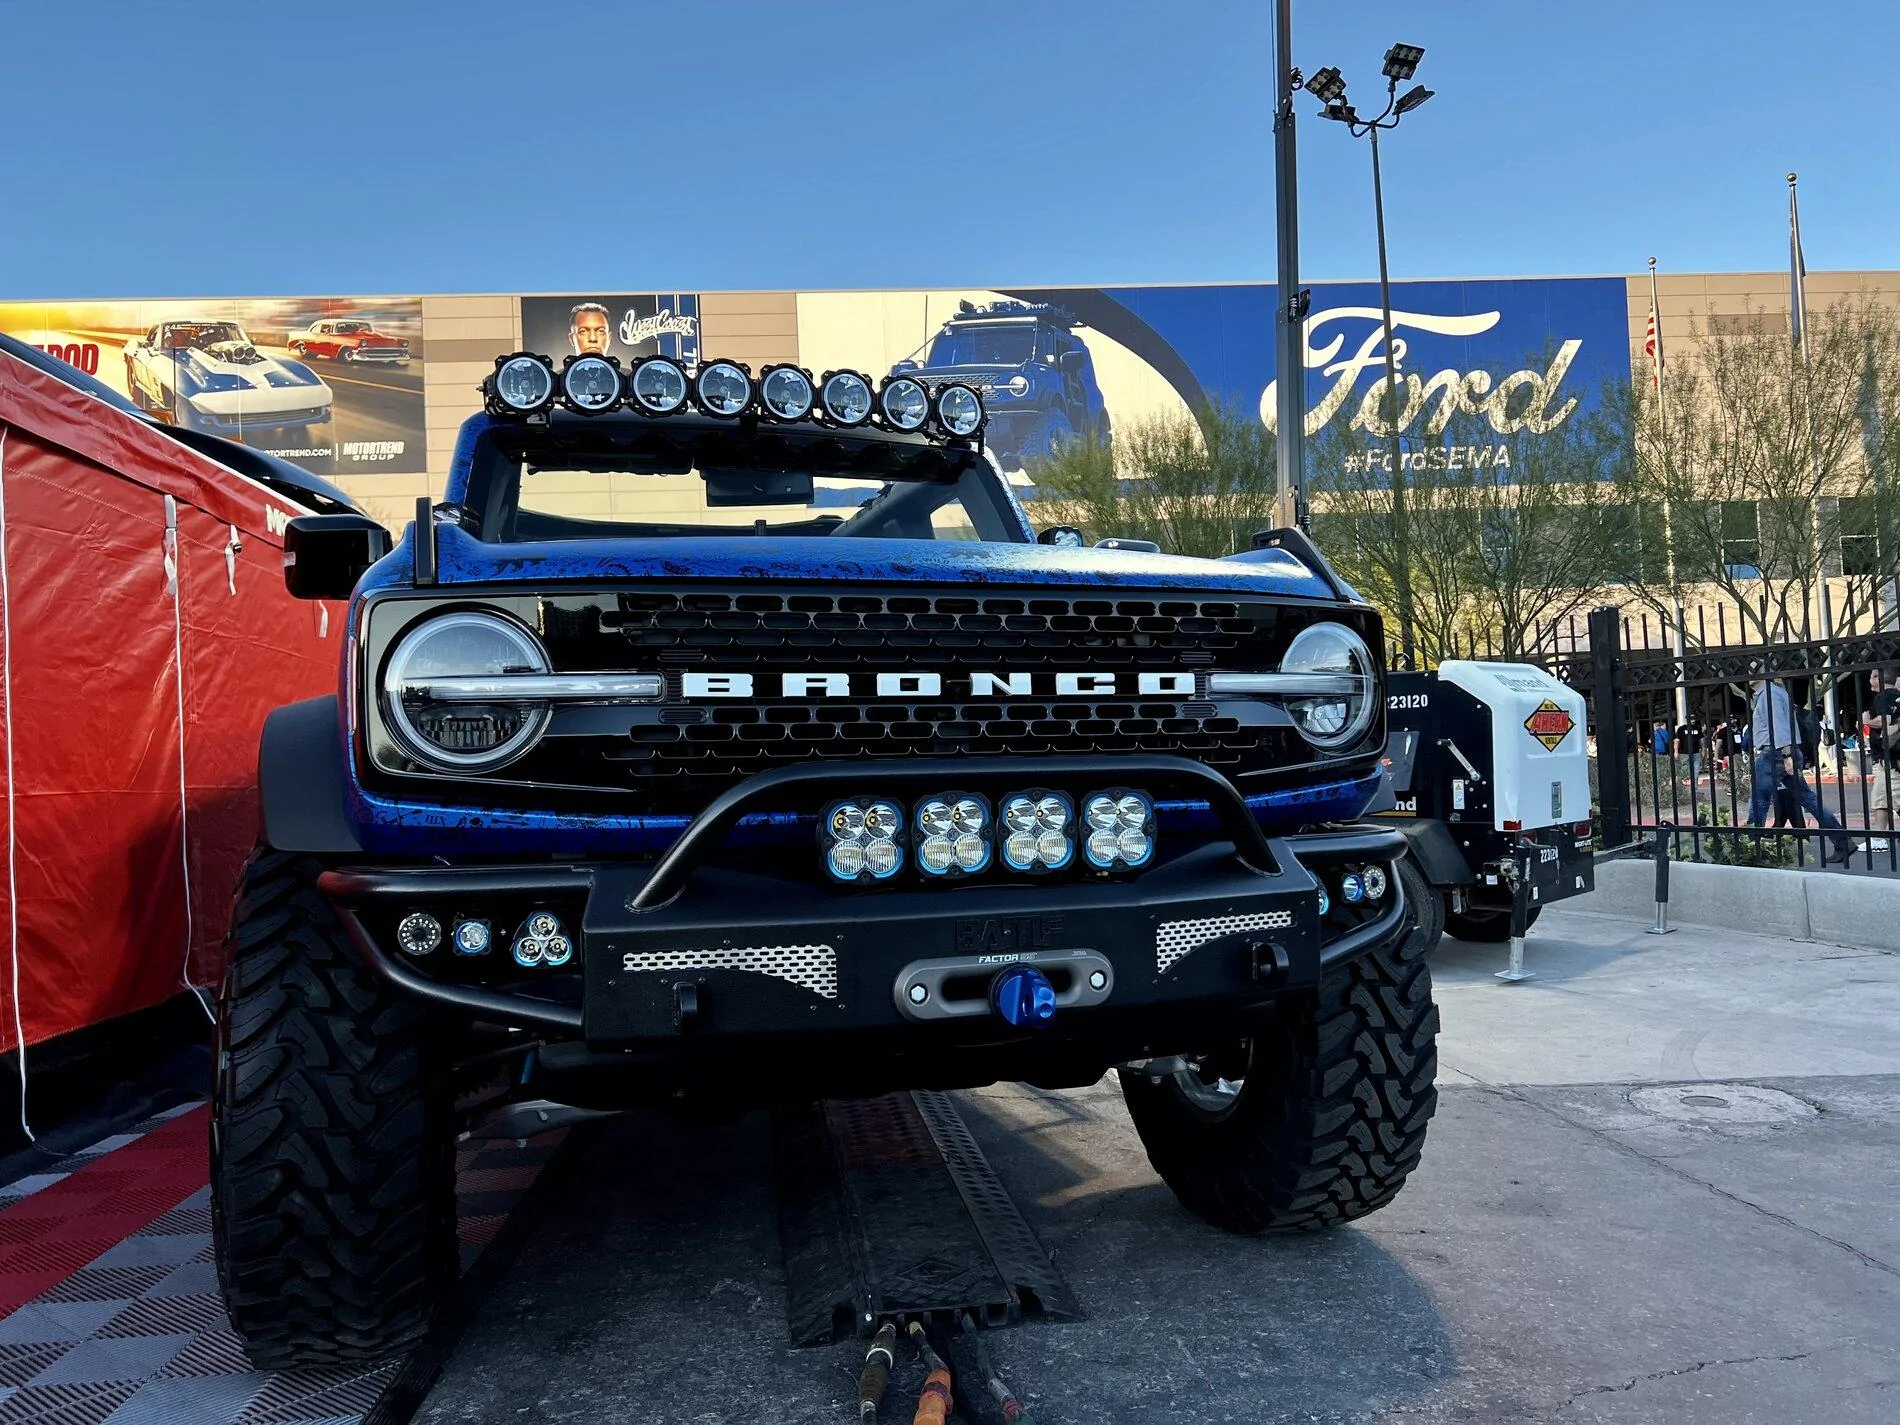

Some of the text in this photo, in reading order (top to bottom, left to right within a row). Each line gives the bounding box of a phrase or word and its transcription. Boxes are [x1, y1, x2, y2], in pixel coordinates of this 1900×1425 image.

[1260, 307, 1582, 437] Ford
[263, 448, 332, 458] OTORTREND.COM
[343, 441, 405, 456] MOTORTREND
[352, 453, 395, 462] GROUP
[682, 672, 1196, 698] BRONCO
[1387, 694, 1429, 710] 23120
[978, 954, 1019, 964] FACTOR
